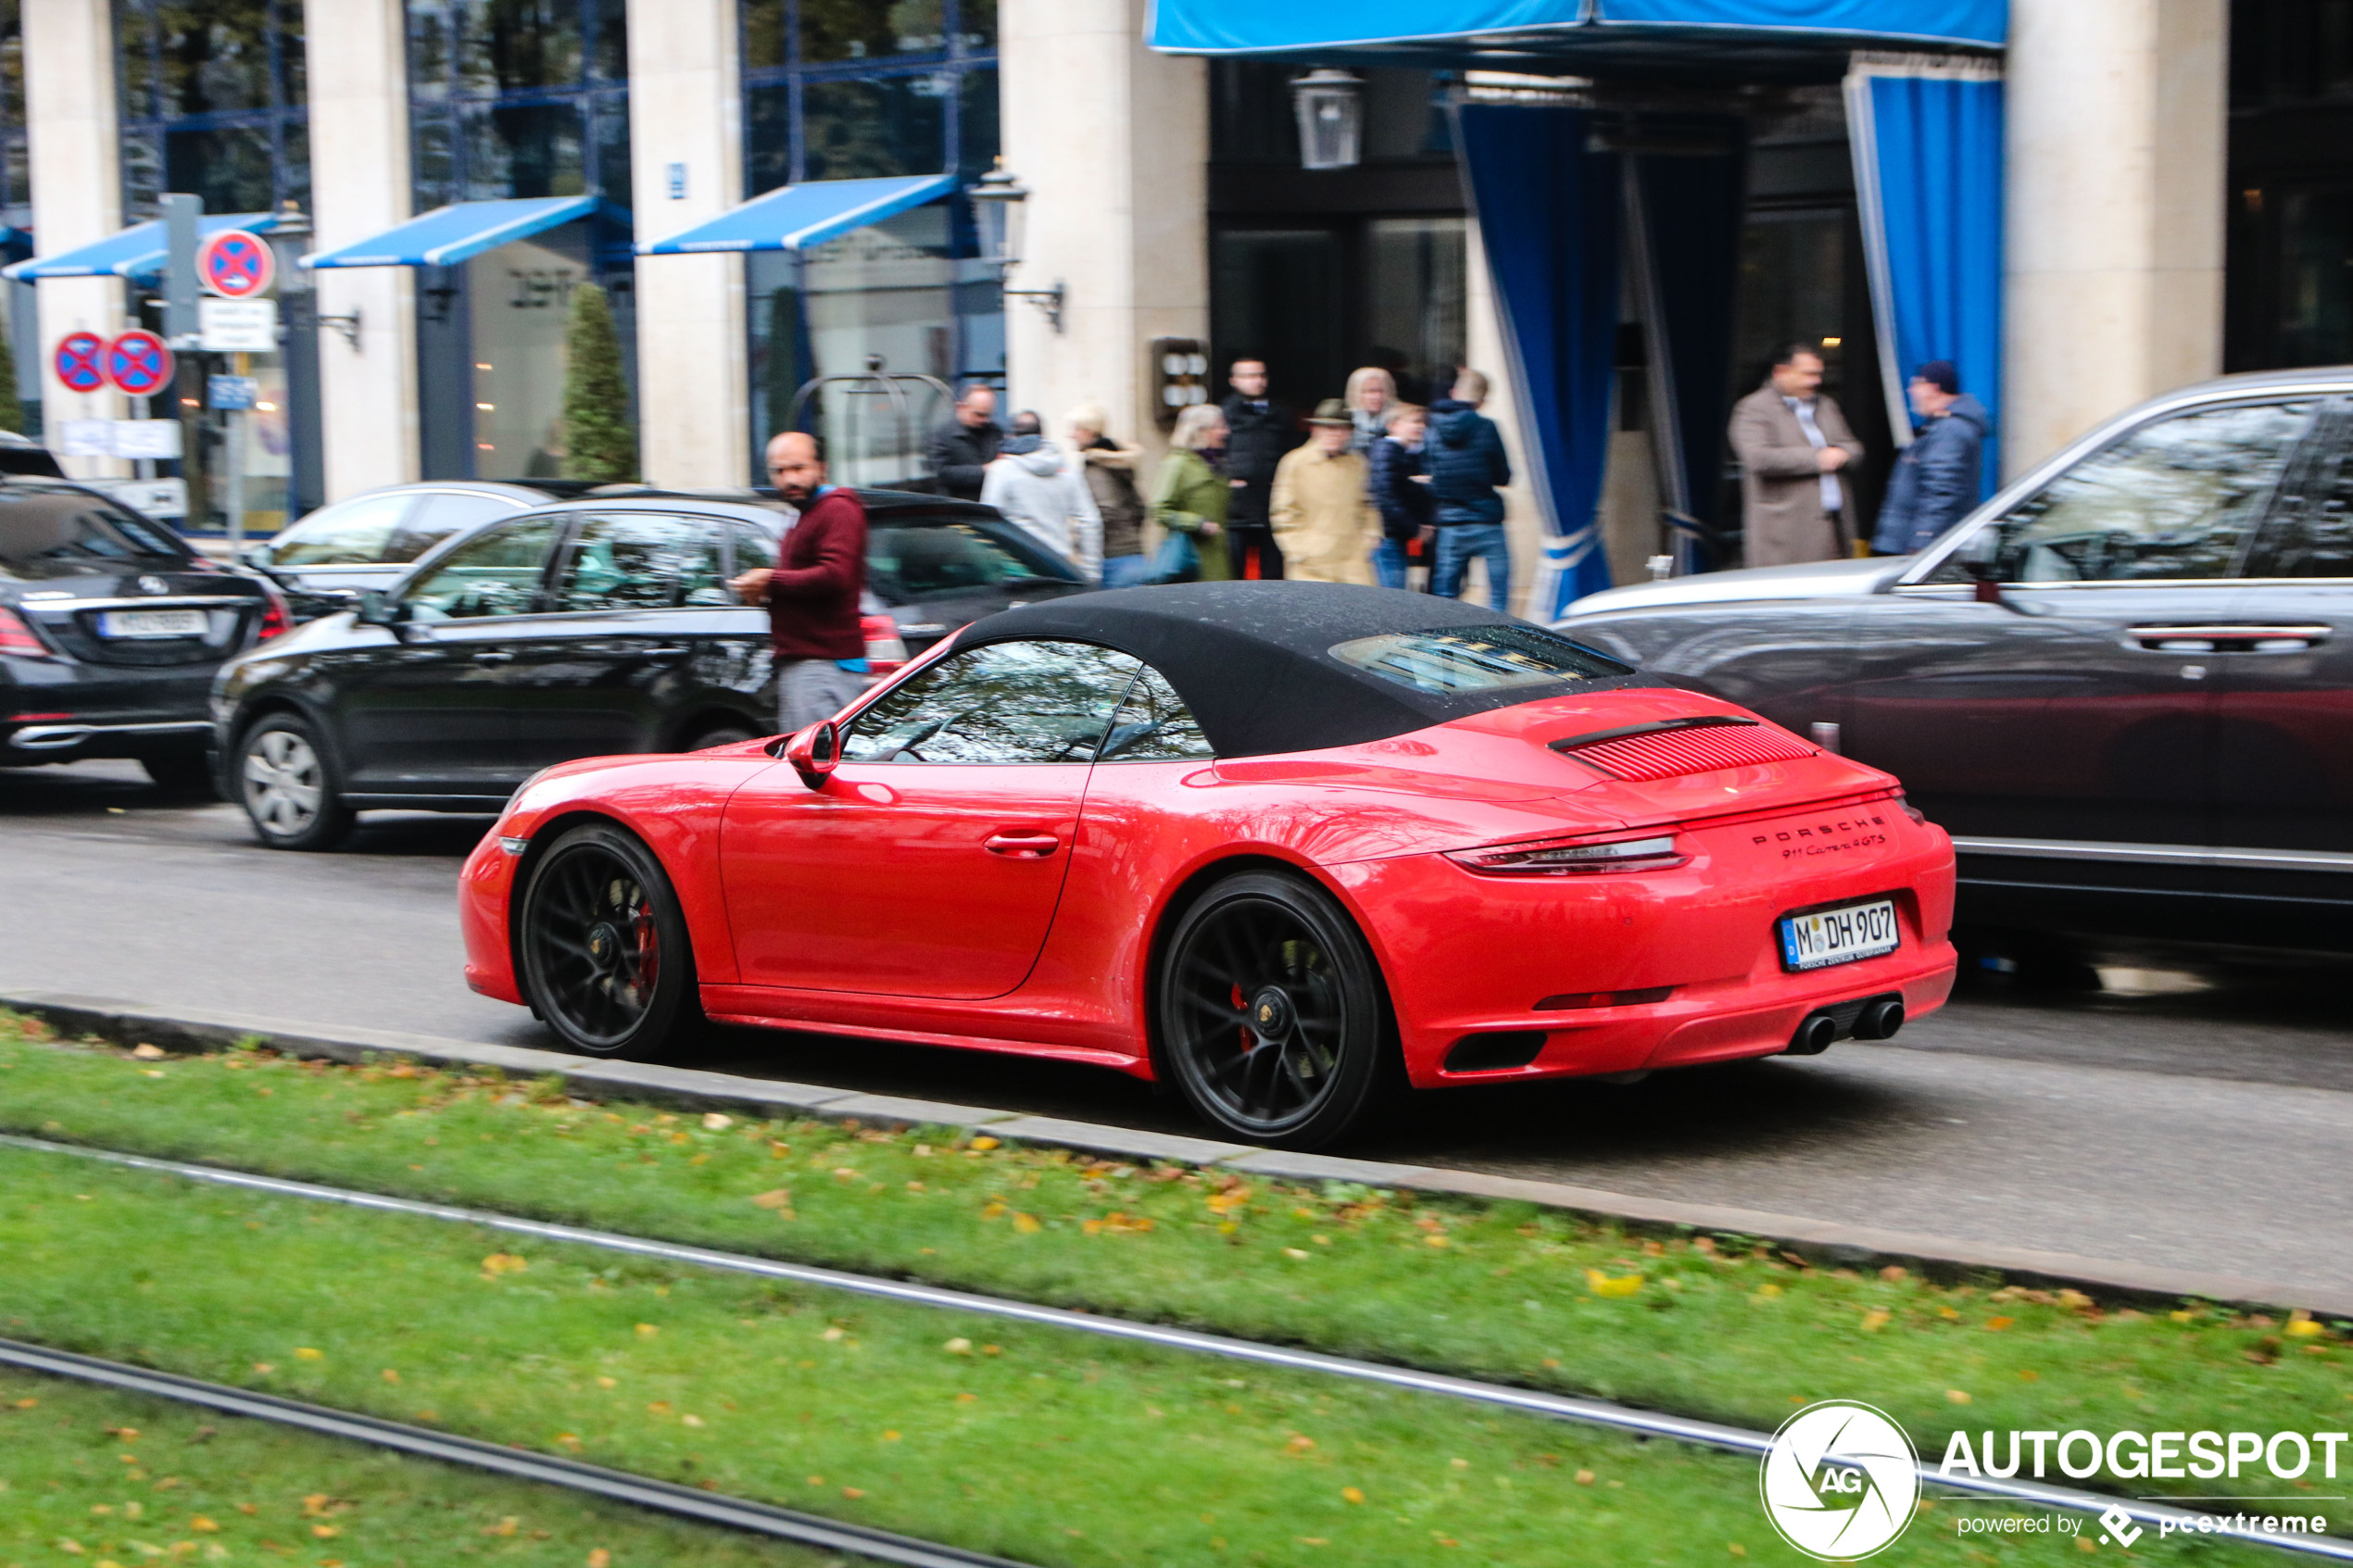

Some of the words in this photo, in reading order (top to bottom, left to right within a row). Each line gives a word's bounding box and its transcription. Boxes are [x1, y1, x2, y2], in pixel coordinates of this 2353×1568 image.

[1752, 816, 1885, 845] PORSCHE
[1782, 848, 1803, 859] 911
[1806, 843, 1852, 855] Carrera
[1861, 834, 1886, 847] GTS
[1795, 921, 1813, 956] M
[1824, 913, 1855, 949] DH
[1856, 906, 1891, 944] 907
[1799, 959, 1826, 970] PORSCHE
